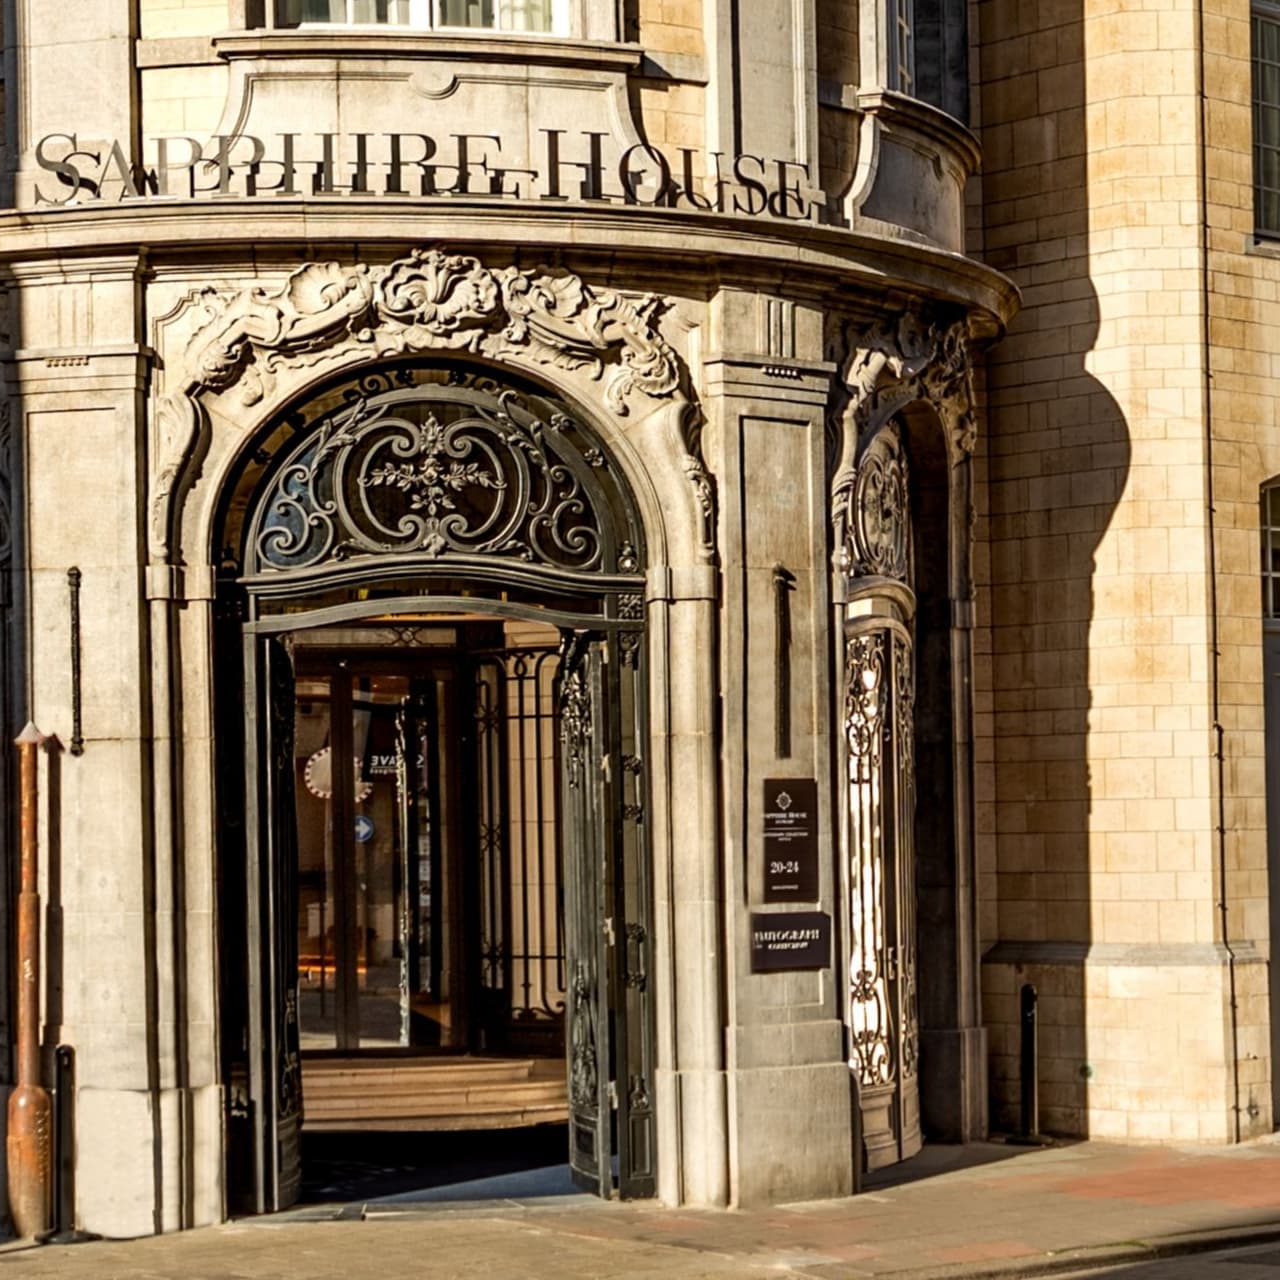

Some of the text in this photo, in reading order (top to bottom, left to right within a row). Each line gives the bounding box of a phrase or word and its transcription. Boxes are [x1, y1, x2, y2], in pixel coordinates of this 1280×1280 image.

[33, 128, 813, 220] SAPPHIRE HOUSE
[770, 860, 799, 874] 20-24
